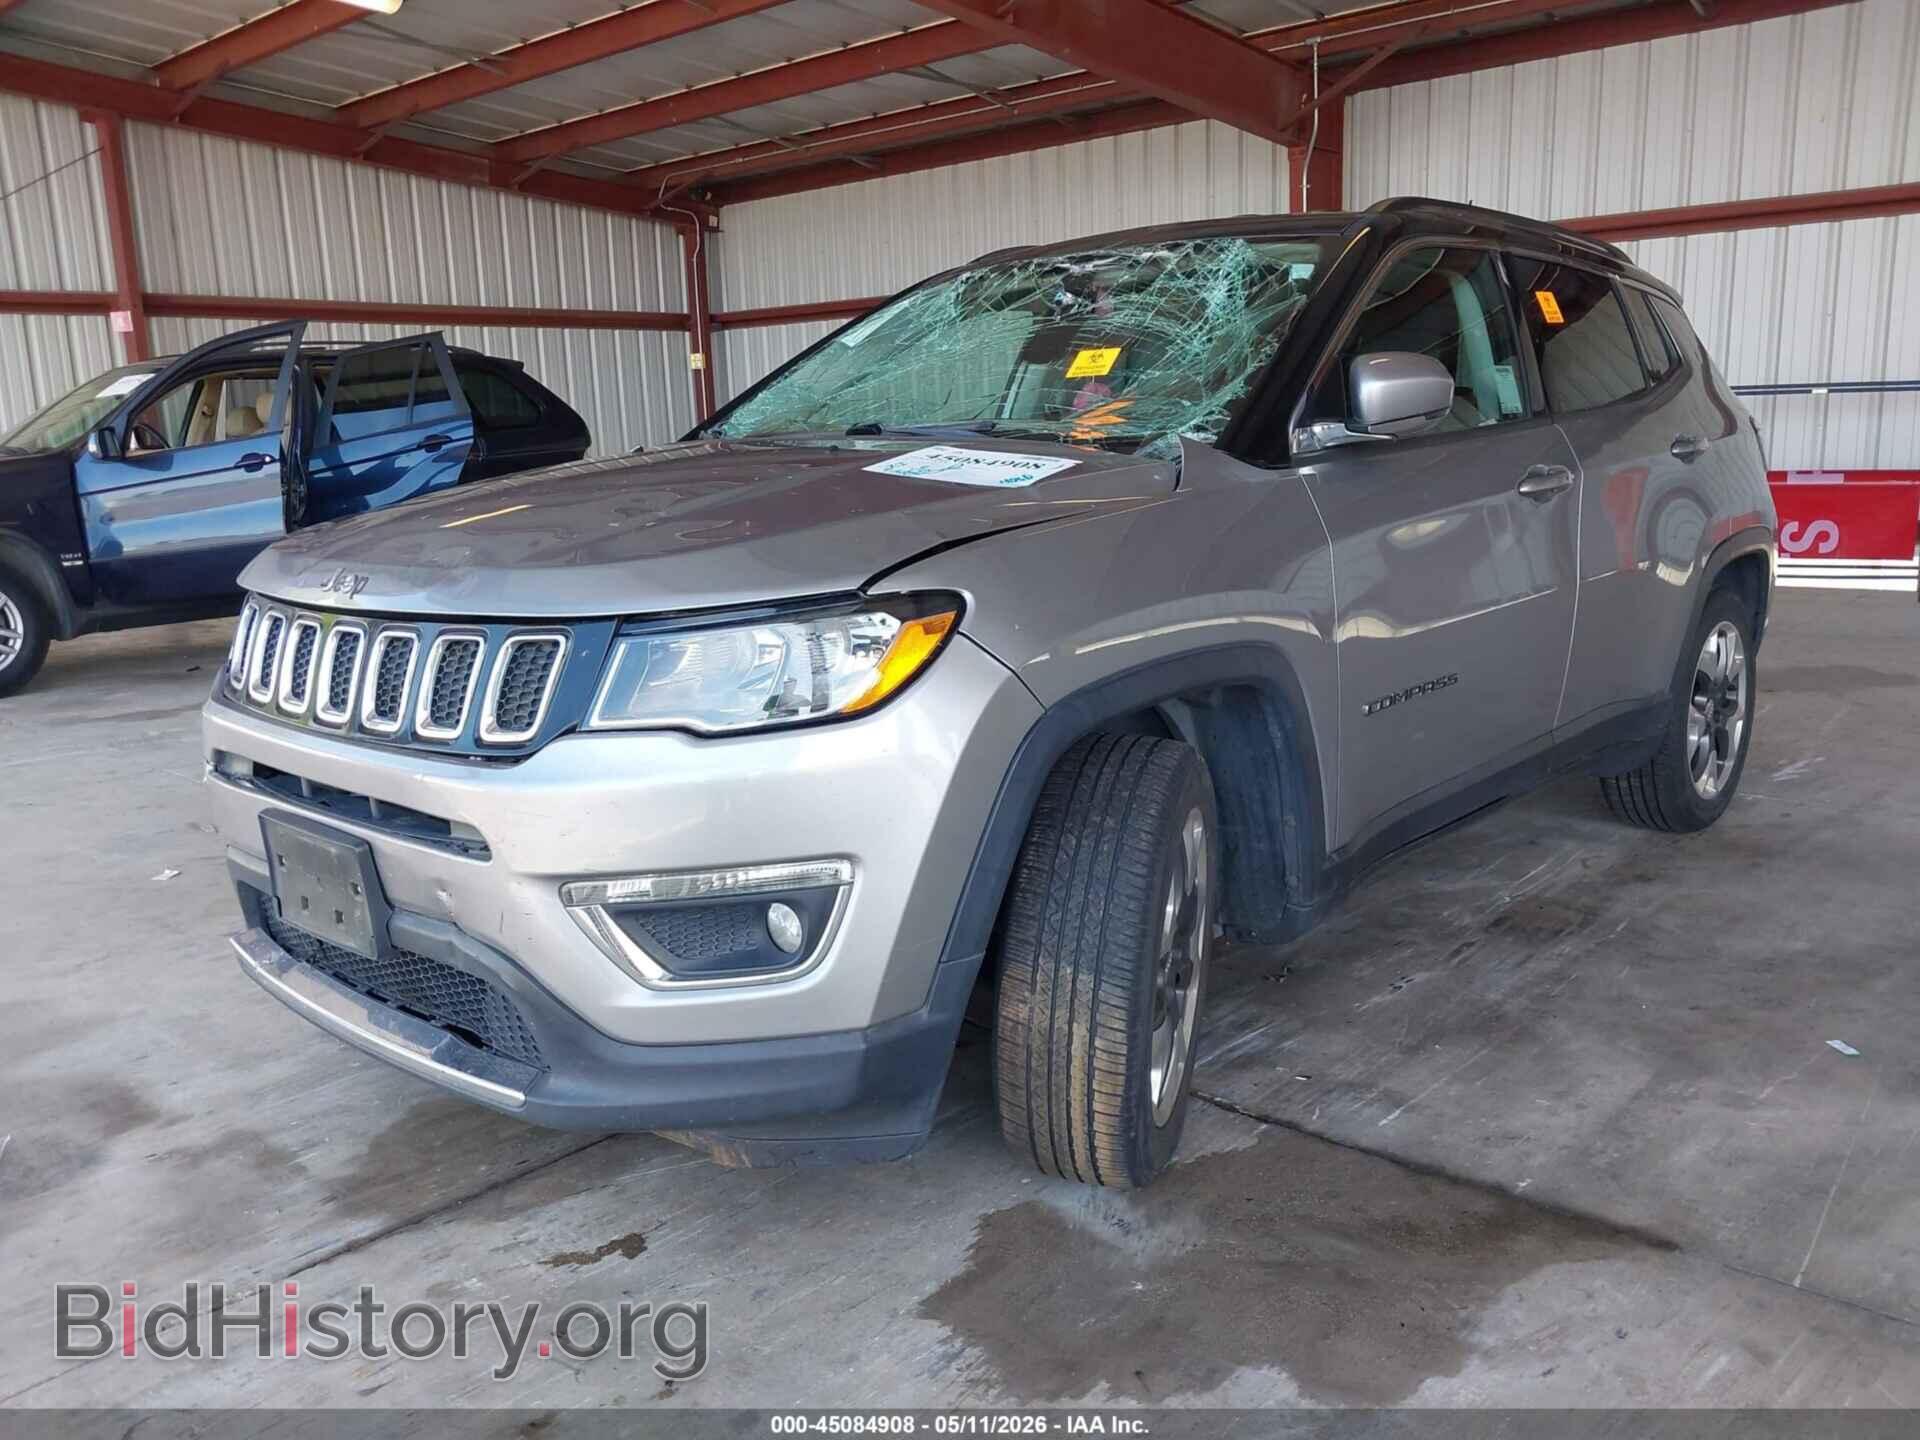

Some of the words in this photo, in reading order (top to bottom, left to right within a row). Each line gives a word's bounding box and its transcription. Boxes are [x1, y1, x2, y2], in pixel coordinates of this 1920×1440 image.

[1780, 519, 1840, 558] S
[320, 567, 369, 600] Jeep
[1362, 672, 1458, 717] COMPASS
